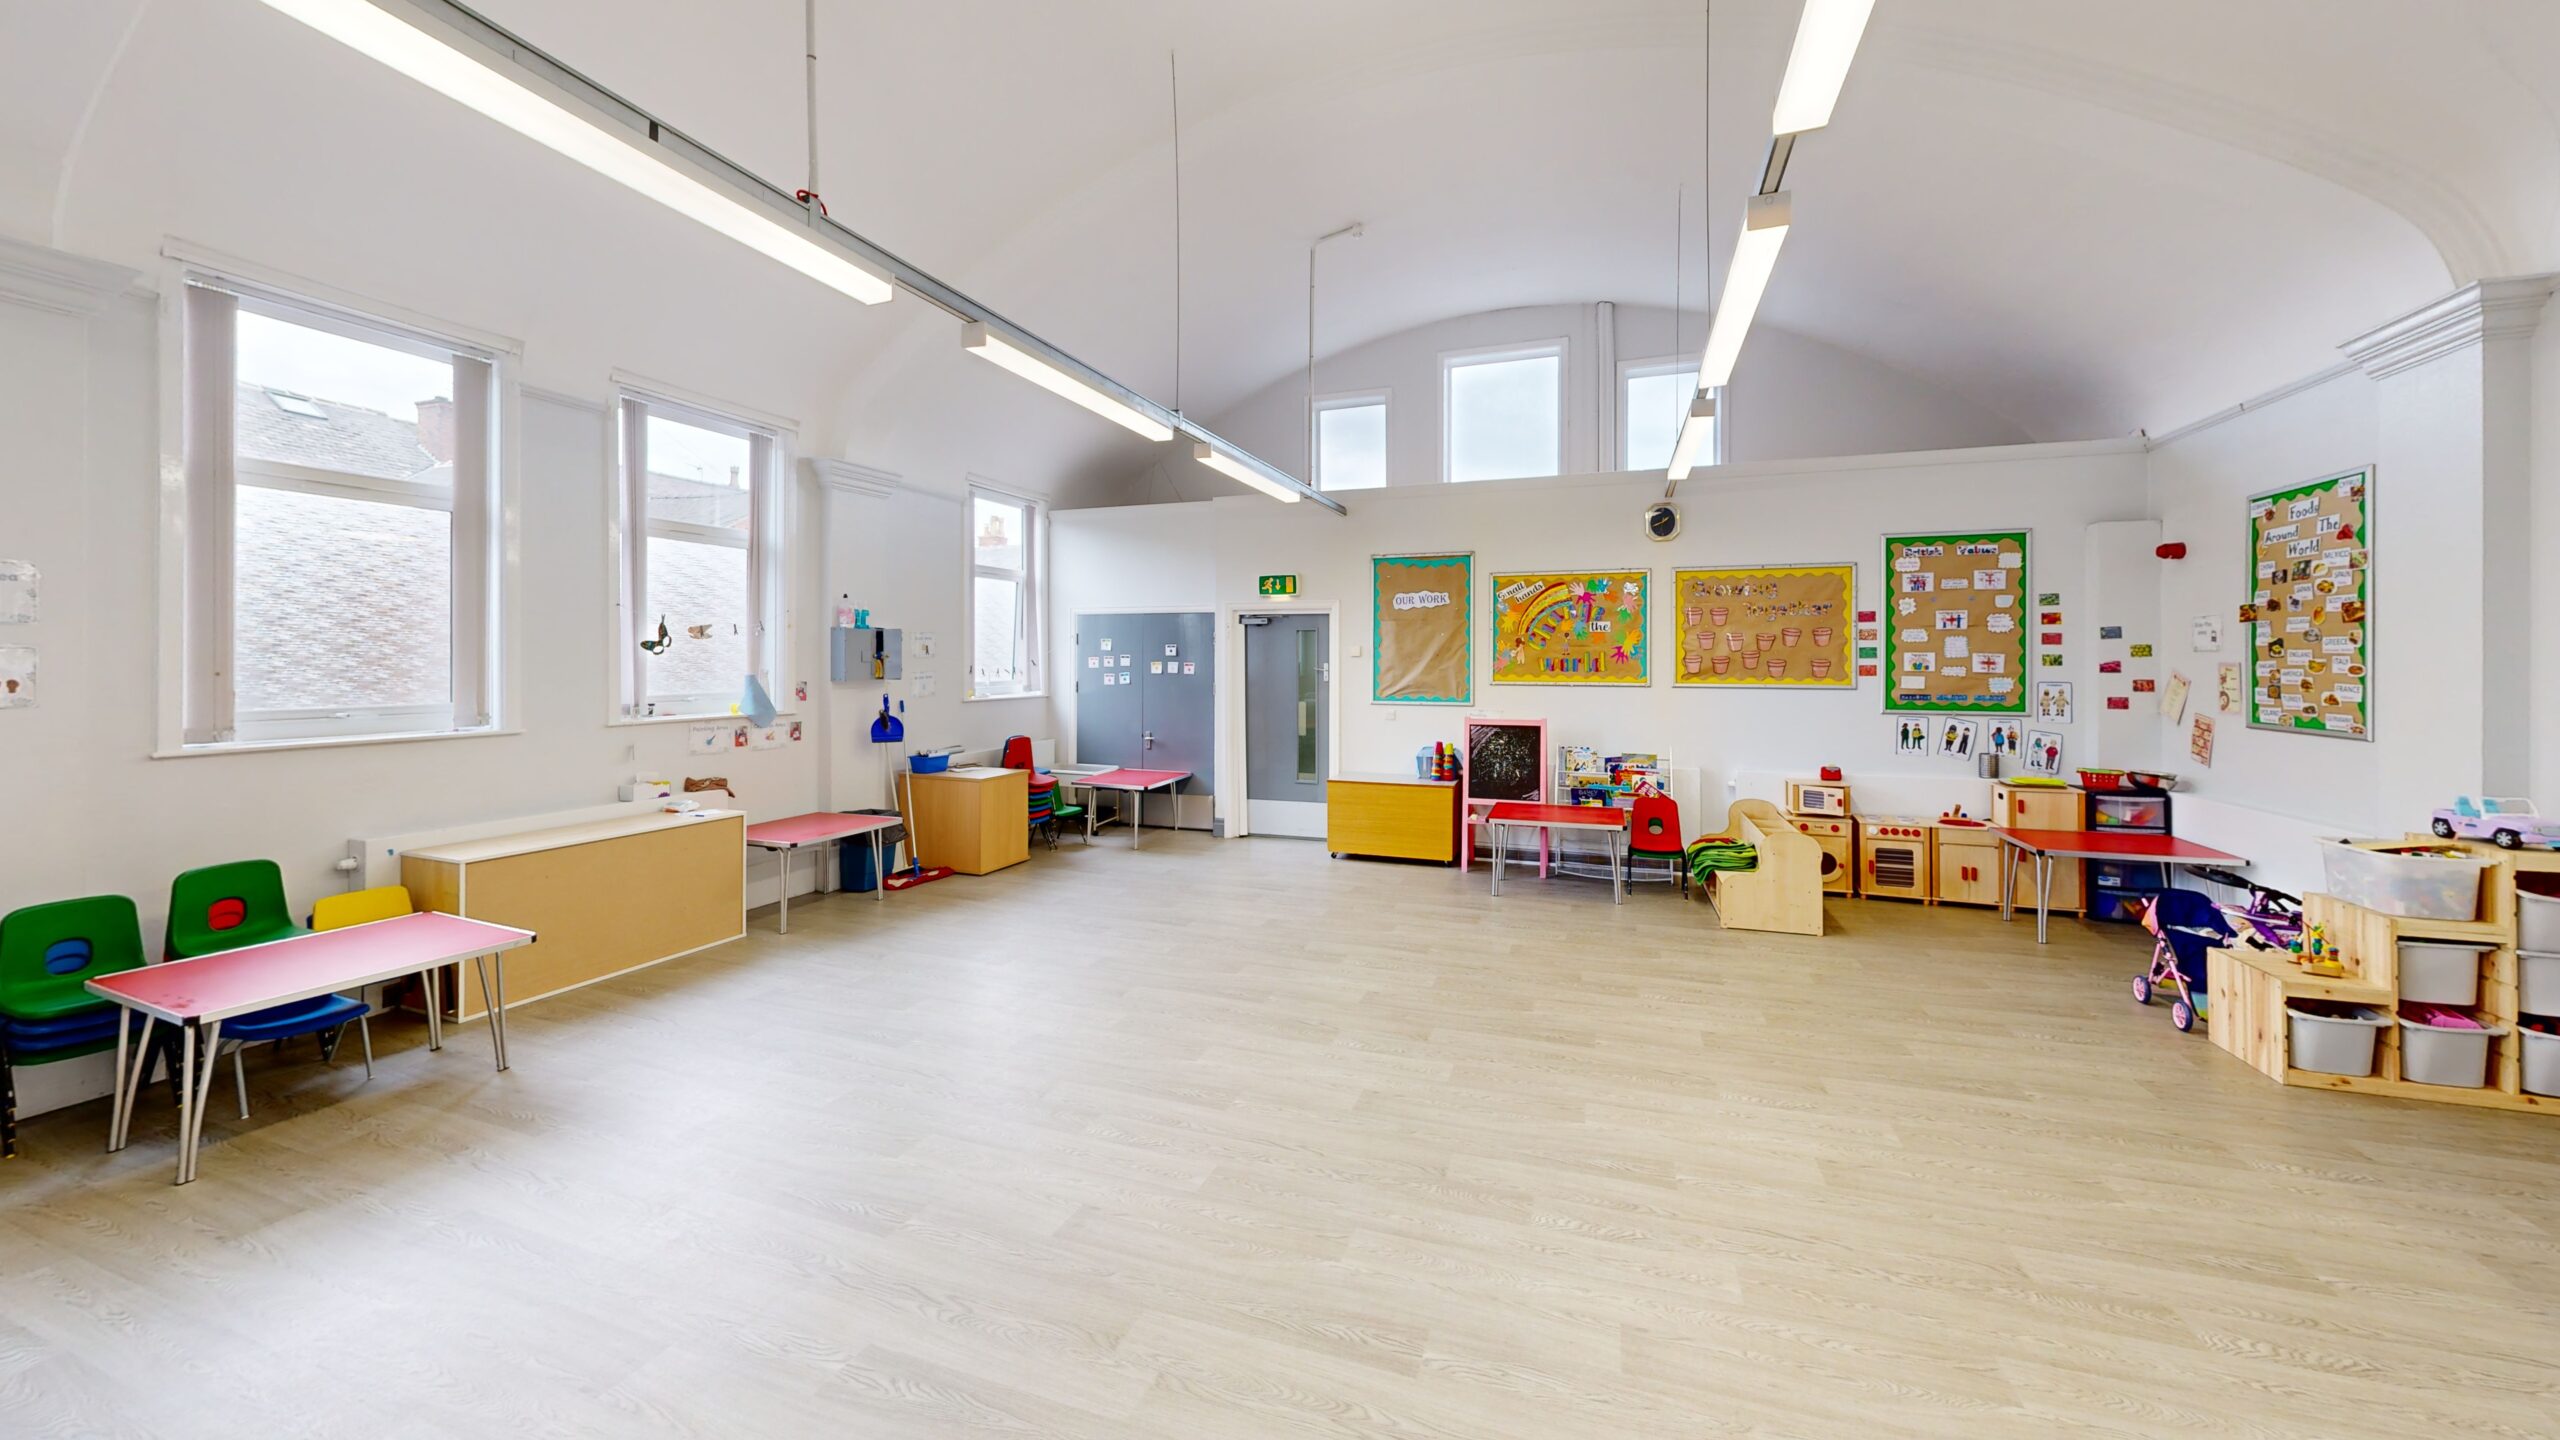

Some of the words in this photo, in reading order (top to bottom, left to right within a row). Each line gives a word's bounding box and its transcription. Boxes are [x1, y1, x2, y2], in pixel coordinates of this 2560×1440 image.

[2289, 501, 2318, 519] Foods
[2265, 526, 2299, 543] Around
[2320, 518, 2339, 531] The
[2288, 539, 2319, 556] World
[1395, 596, 1415, 606] OUR
[1418, 593, 1448, 604] WORK
[1515, 584, 1543, 603] hands
[1591, 622, 1609, 631] the
[1539, 652, 1606, 673] world
